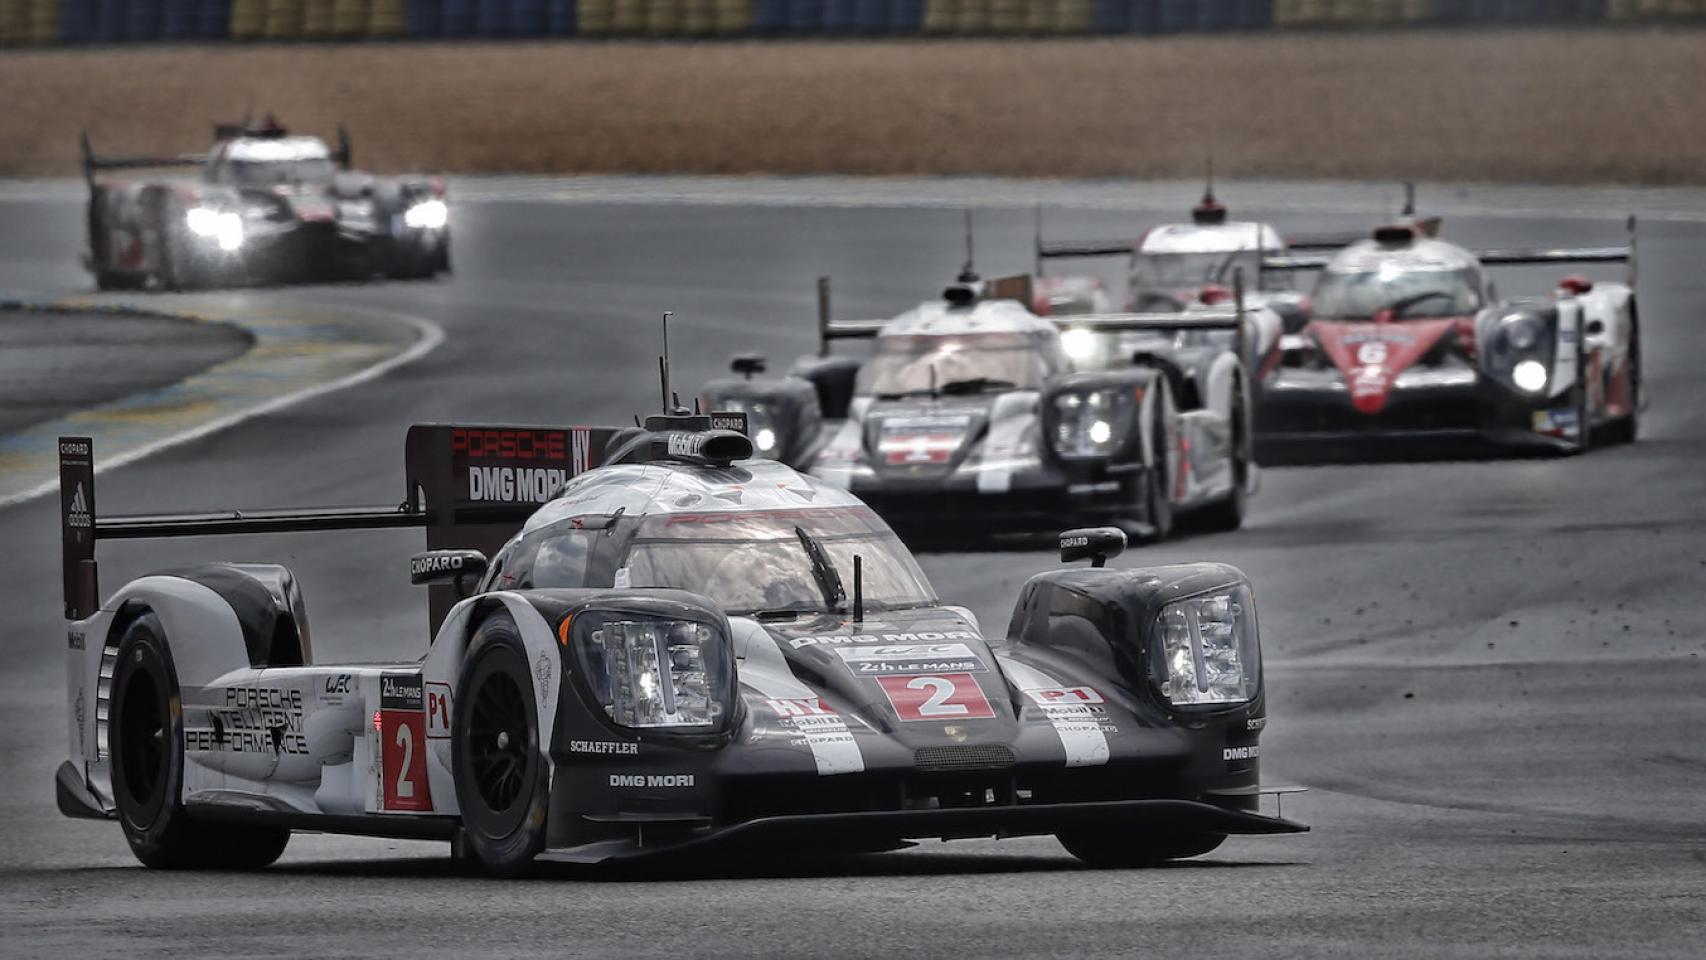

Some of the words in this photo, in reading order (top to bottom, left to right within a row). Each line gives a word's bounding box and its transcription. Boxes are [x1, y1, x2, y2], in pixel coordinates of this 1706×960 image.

[1357, 341, 1387, 364] 6
[713, 418, 744, 430] CHOPARD
[452, 430, 566, 458] PORSCHE
[571, 429, 592, 476] HY
[469, 466, 515, 501] DMG
[411, 556, 463, 574] CHOPARD
[788, 634, 879, 649] DMG
[882, 631, 984, 641] MORI
[873, 644, 955, 656] WC
[898, 663, 921, 671] LE
[923, 661, 976, 671] MANS
[325, 674, 352, 694] WEC
[226, 687, 302, 709] PORSCHE
[906, 676, 969, 716] 2
[1040, 689, 1090, 701] P1
[428, 692, 449, 730] P1
[766, 699, 826, 716] HY
[777, 717, 827, 728] Mobil
[1056, 725, 1119, 733] CHOPARD
[570, 740, 639, 754] SCHAEFFLER
[791, 736, 854, 746] CHOPARD
[396, 722, 414, 798] 2
[1222, 747, 1248, 760] DMG
[609, 774, 646, 787] DMG
[647, 774, 695, 787] MORI
